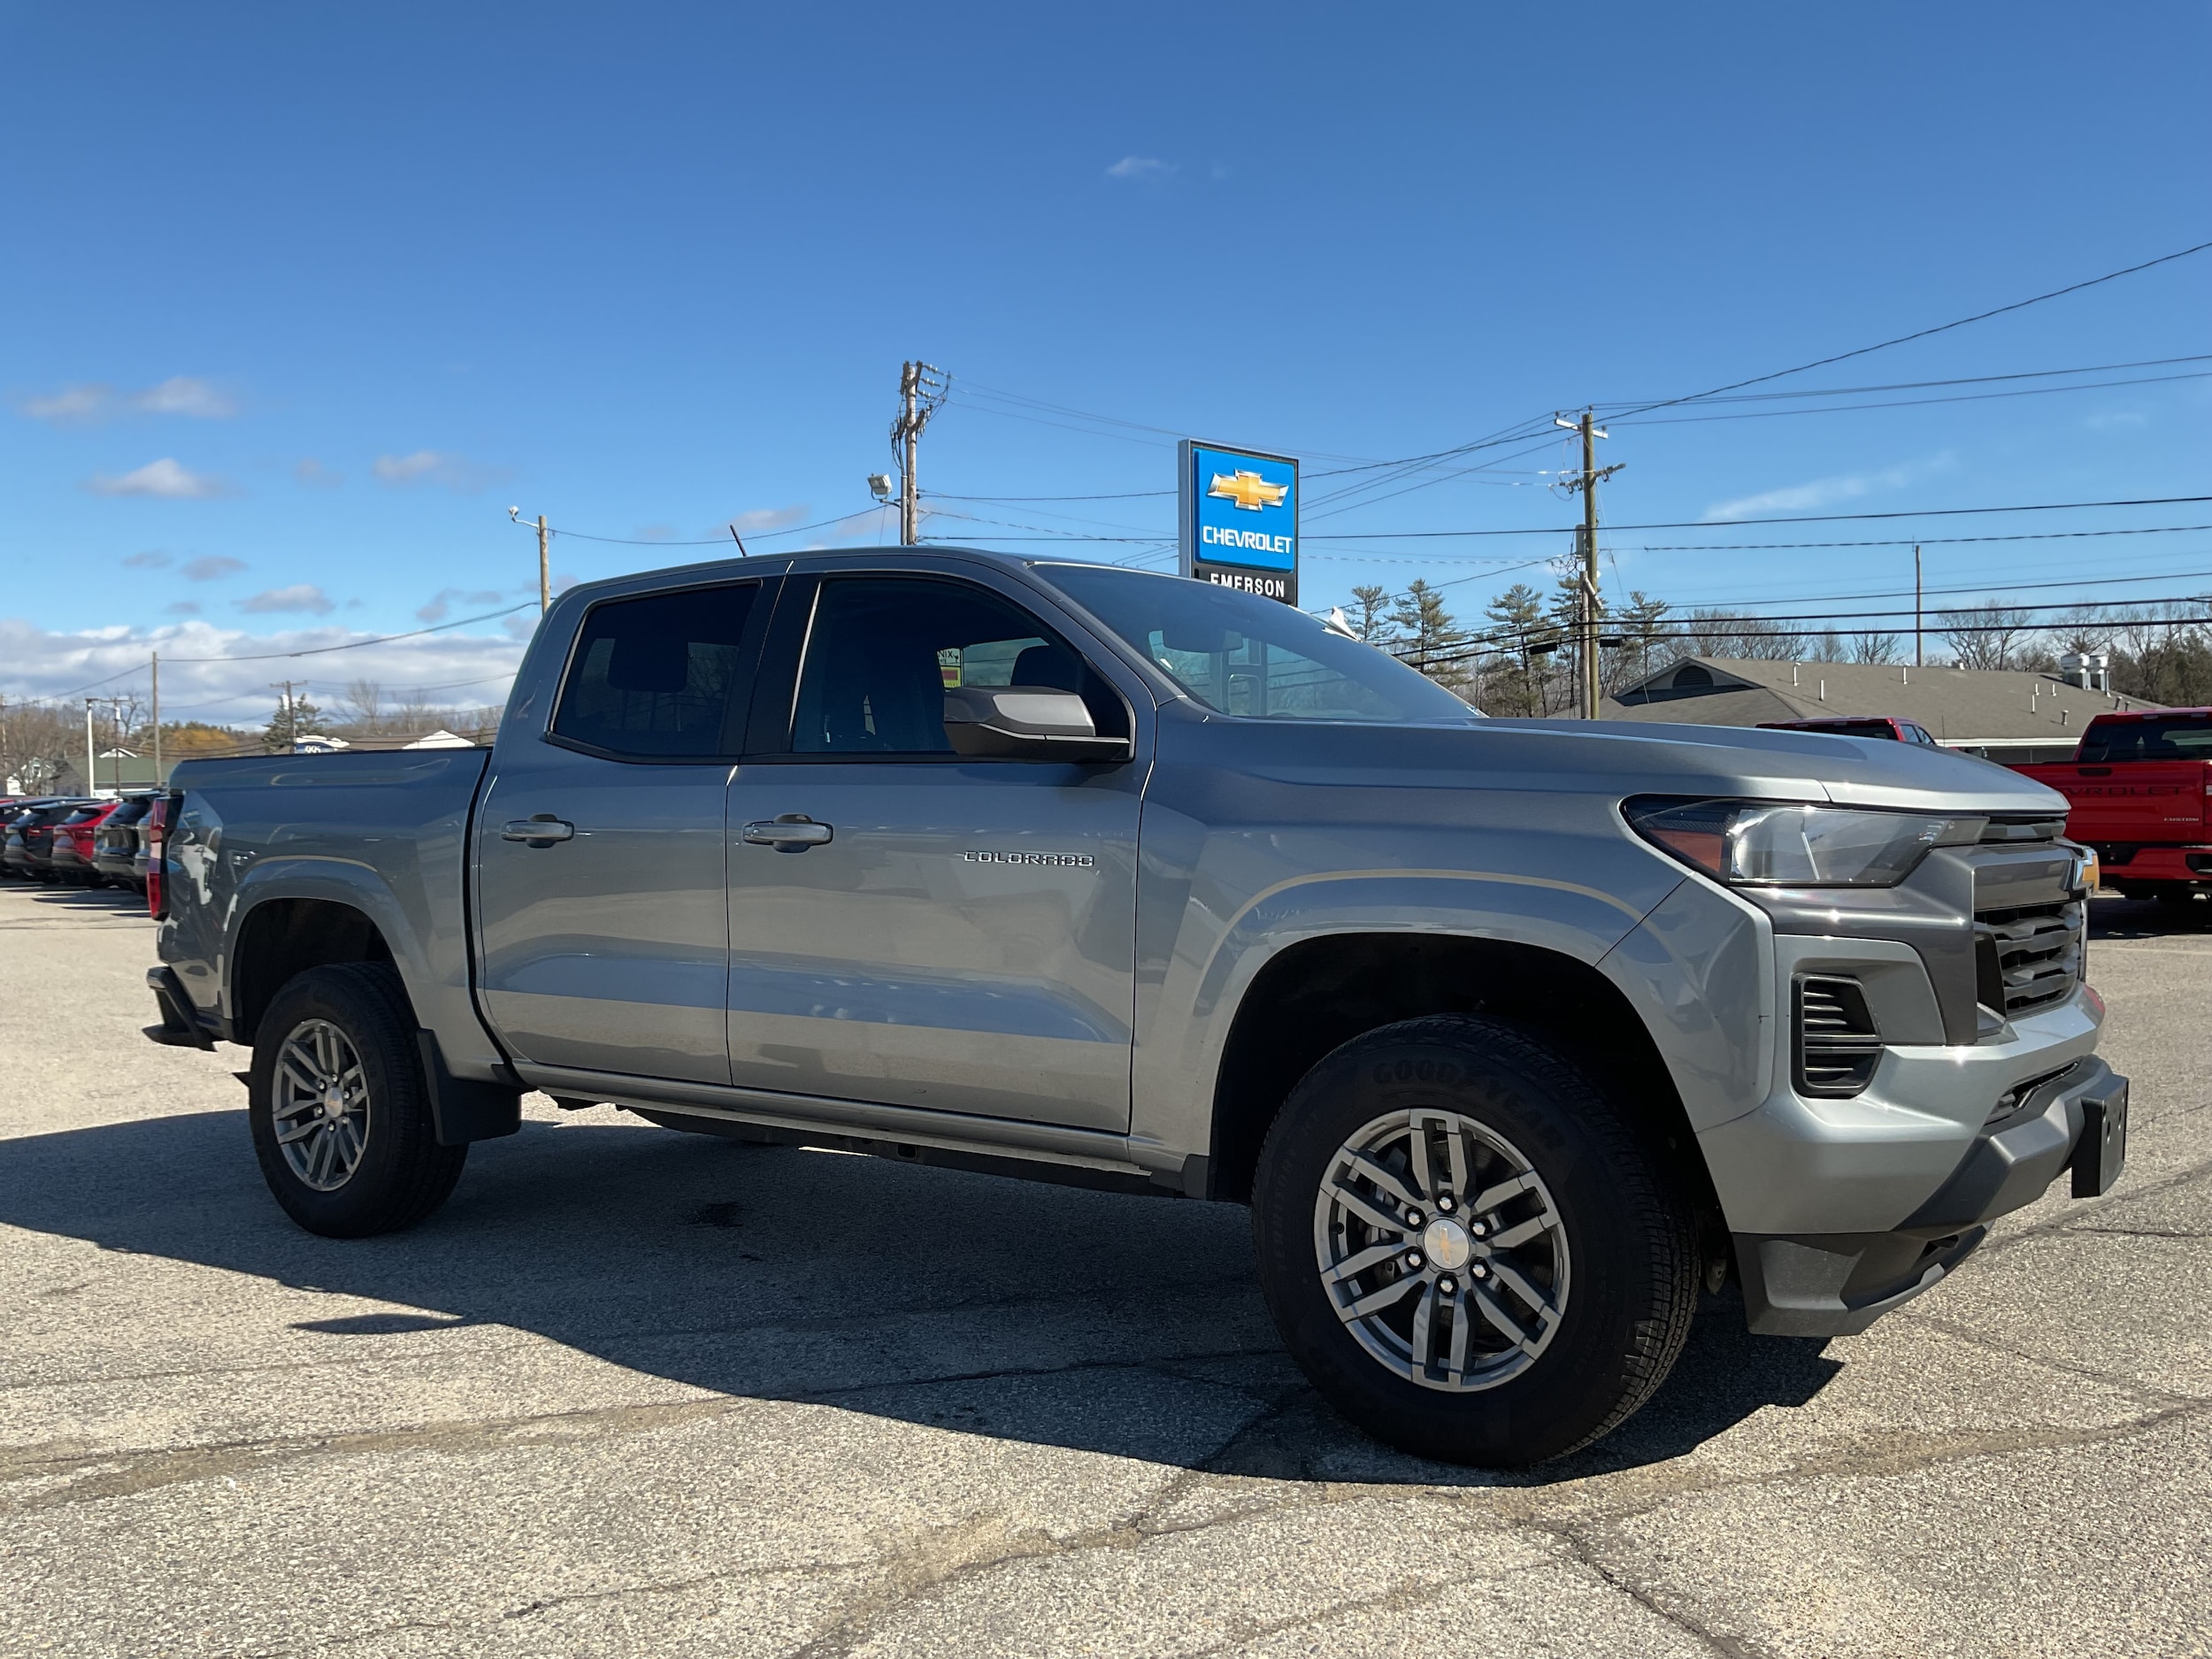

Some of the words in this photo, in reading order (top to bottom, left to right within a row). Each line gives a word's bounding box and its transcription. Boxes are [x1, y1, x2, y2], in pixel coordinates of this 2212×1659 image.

[1202, 525, 1293, 554] CHEVROLET
[1210, 572, 1285, 598] EMERSON
[964, 850, 1094, 867] COLORADO
[1372, 1058, 1568, 1150] GOODYEAR
